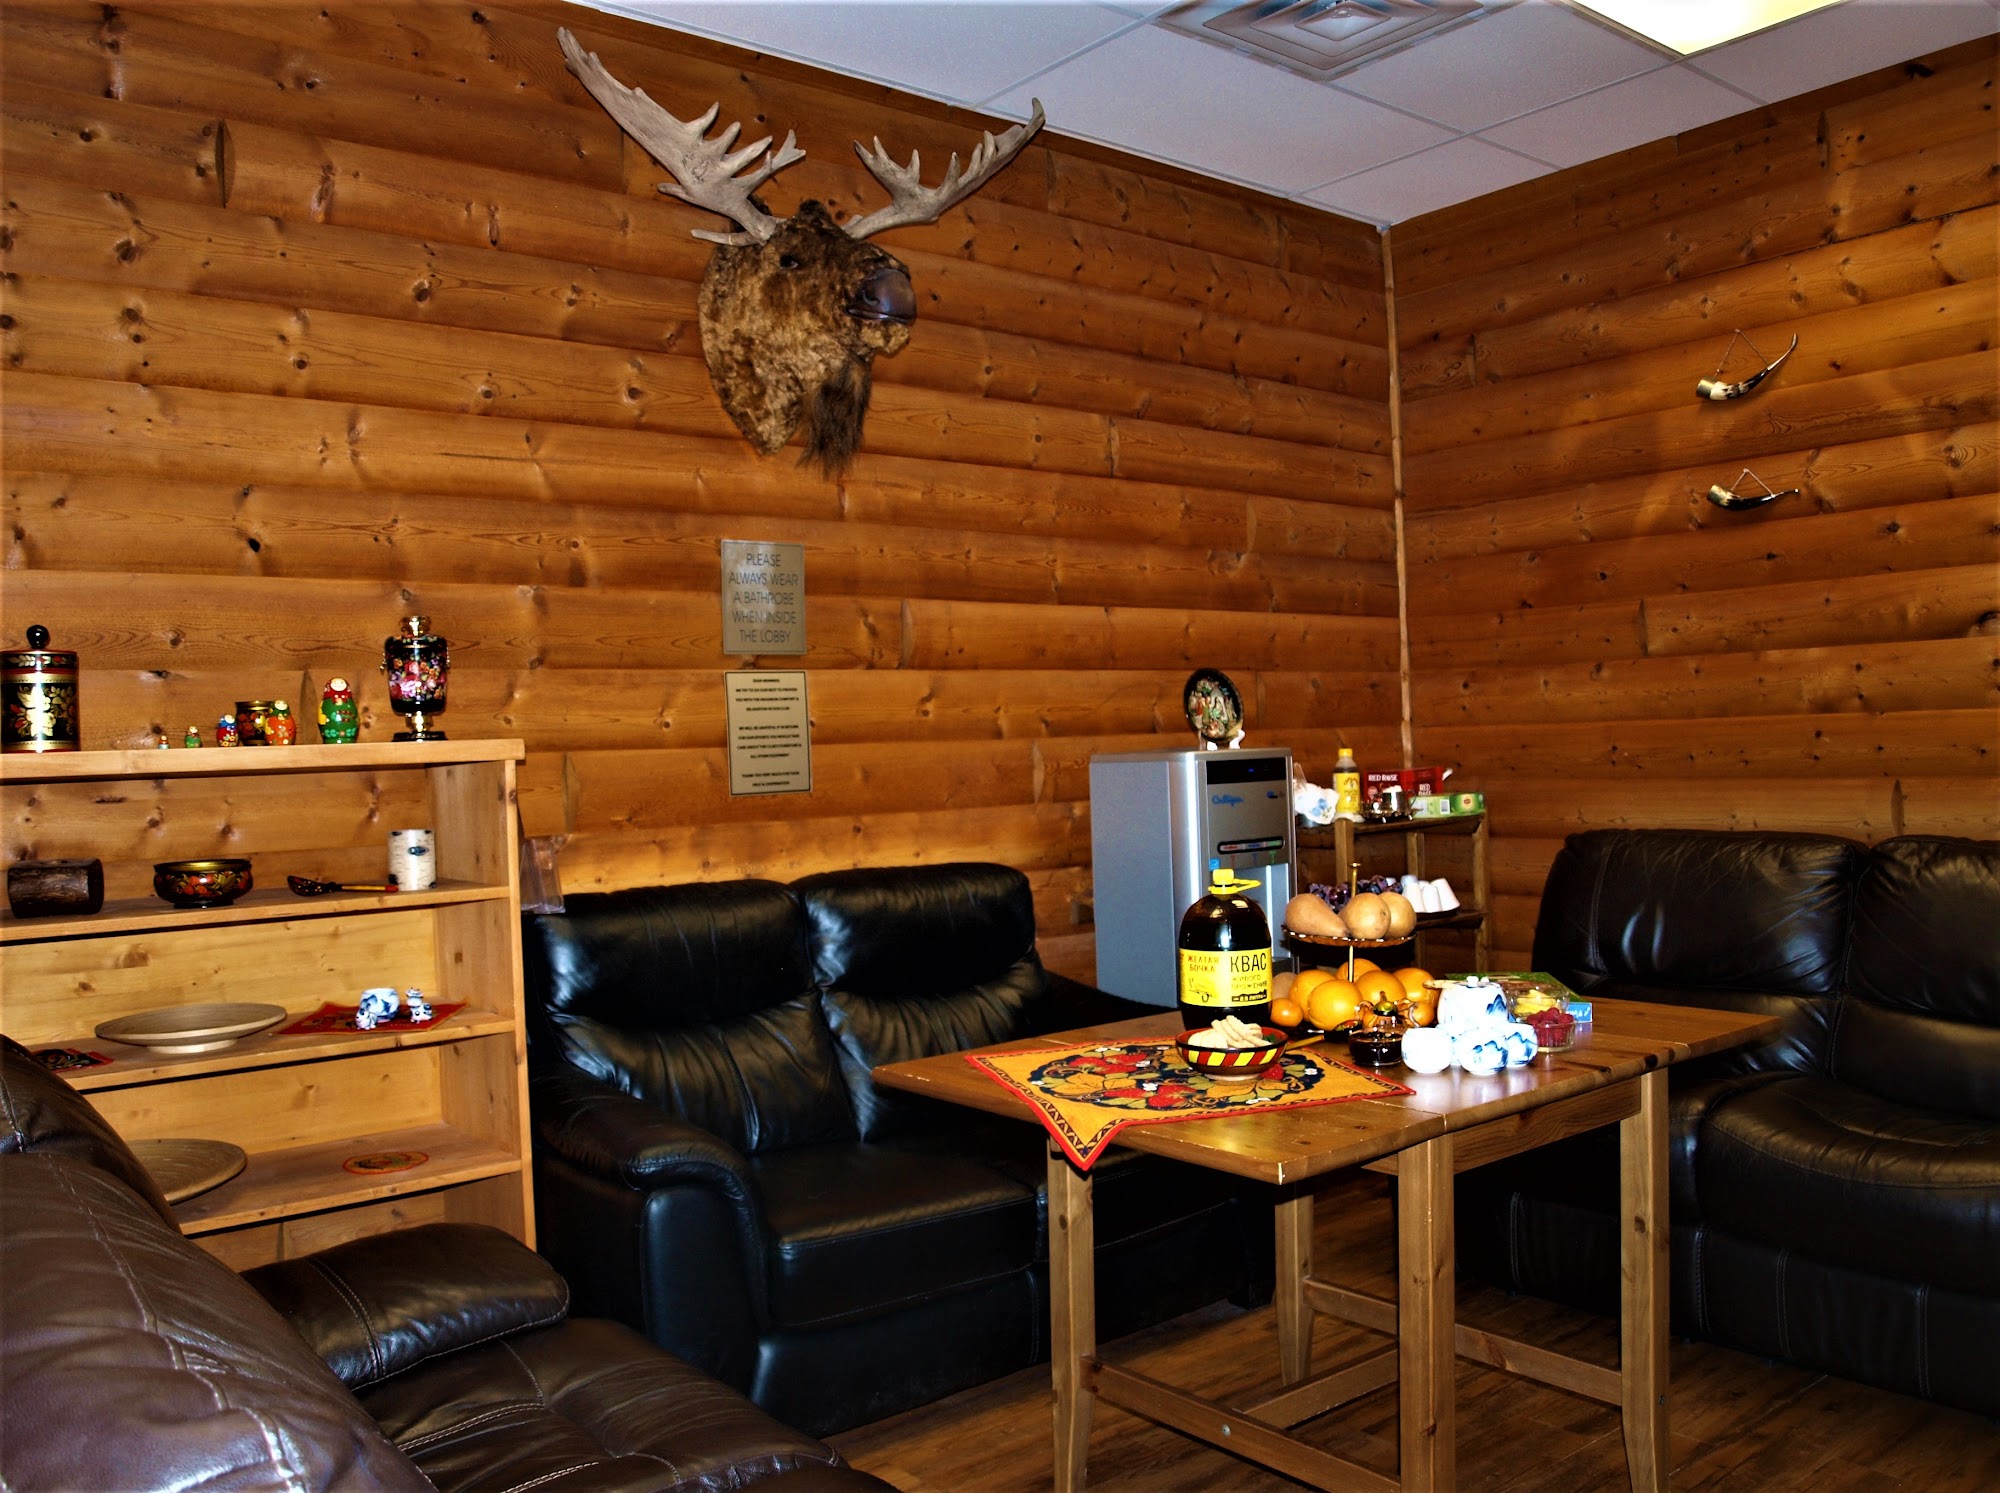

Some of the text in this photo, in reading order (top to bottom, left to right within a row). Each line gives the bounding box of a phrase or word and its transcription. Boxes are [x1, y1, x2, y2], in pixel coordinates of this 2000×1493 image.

[746, 553, 781, 567] PLEASE
[728, 572, 798, 586] ALWAYS WEAR
[733, 591, 795, 605] A BATHROBE
[732, 611, 797, 624] WHEN INSIDE
[739, 630, 791, 643] THE LOBBY
[1368, 774, 1398, 782] RED ROSE
[1419, 783, 1431, 791] RED
[1189, 963, 1215, 972] БОЧКА
[1230, 952, 1267, 973] КВАС
